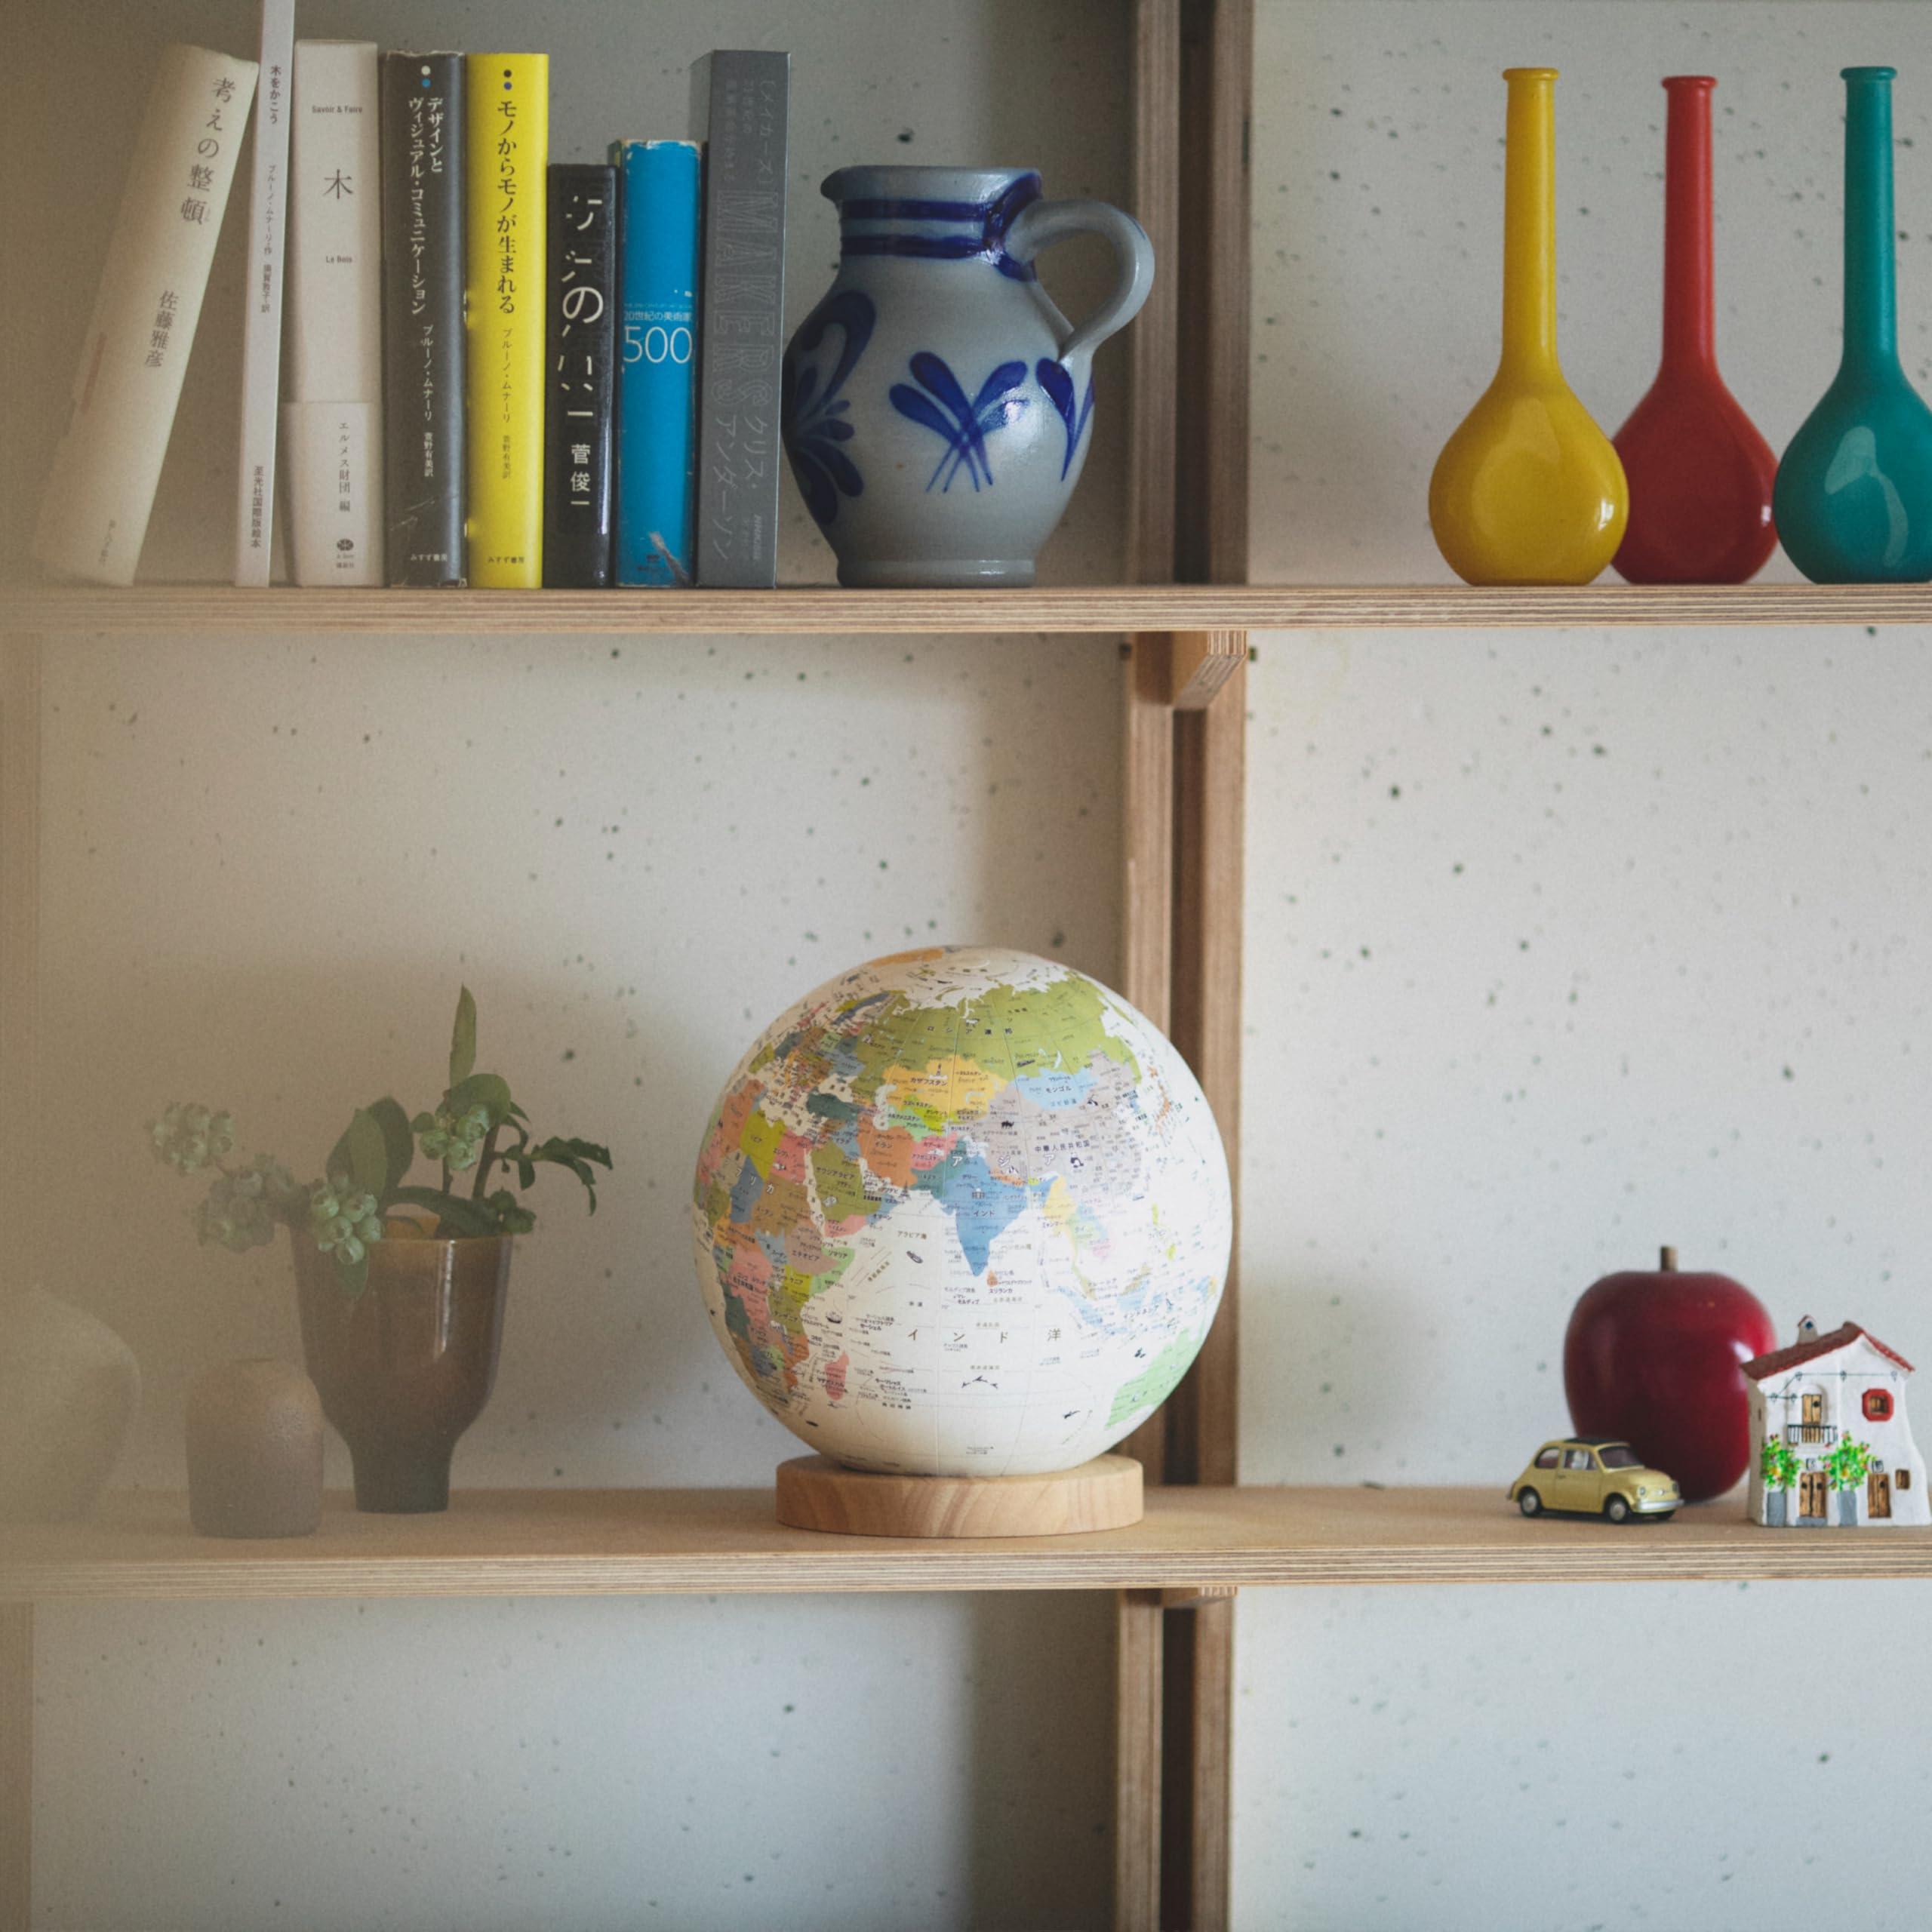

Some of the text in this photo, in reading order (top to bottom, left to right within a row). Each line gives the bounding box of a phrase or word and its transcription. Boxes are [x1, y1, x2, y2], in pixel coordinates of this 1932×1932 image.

[269, 66, 282, 125] 木をかこう
[180, 77, 236, 225] 考えの整頓
[427, 97, 444, 173] デザインと
[322, 168, 353, 200] 木
[408, 97, 426, 315] ヴィジュアル・コミュニケーション
[497, 100, 518, 315] モノからモノが生まれる
[145, 291, 179, 368] 佐藤雅彦
[623, 326, 693, 364] 500
[420, 325, 433, 422] ブルーノ・ムナーリ
[501, 328, 514, 423] ブルーノ・ムナーリ
[339, 422, 350, 494] エルメス財団
[571, 444, 591, 505] 菅俊一
[910, 1077, 948, 1087] カザフスタン
[816, 1167, 854, 1180] サウジアラビア
[1035, 1140, 1090, 1152] 中華人民共和国
[897, 1230, 927, 1240] アラビア海
